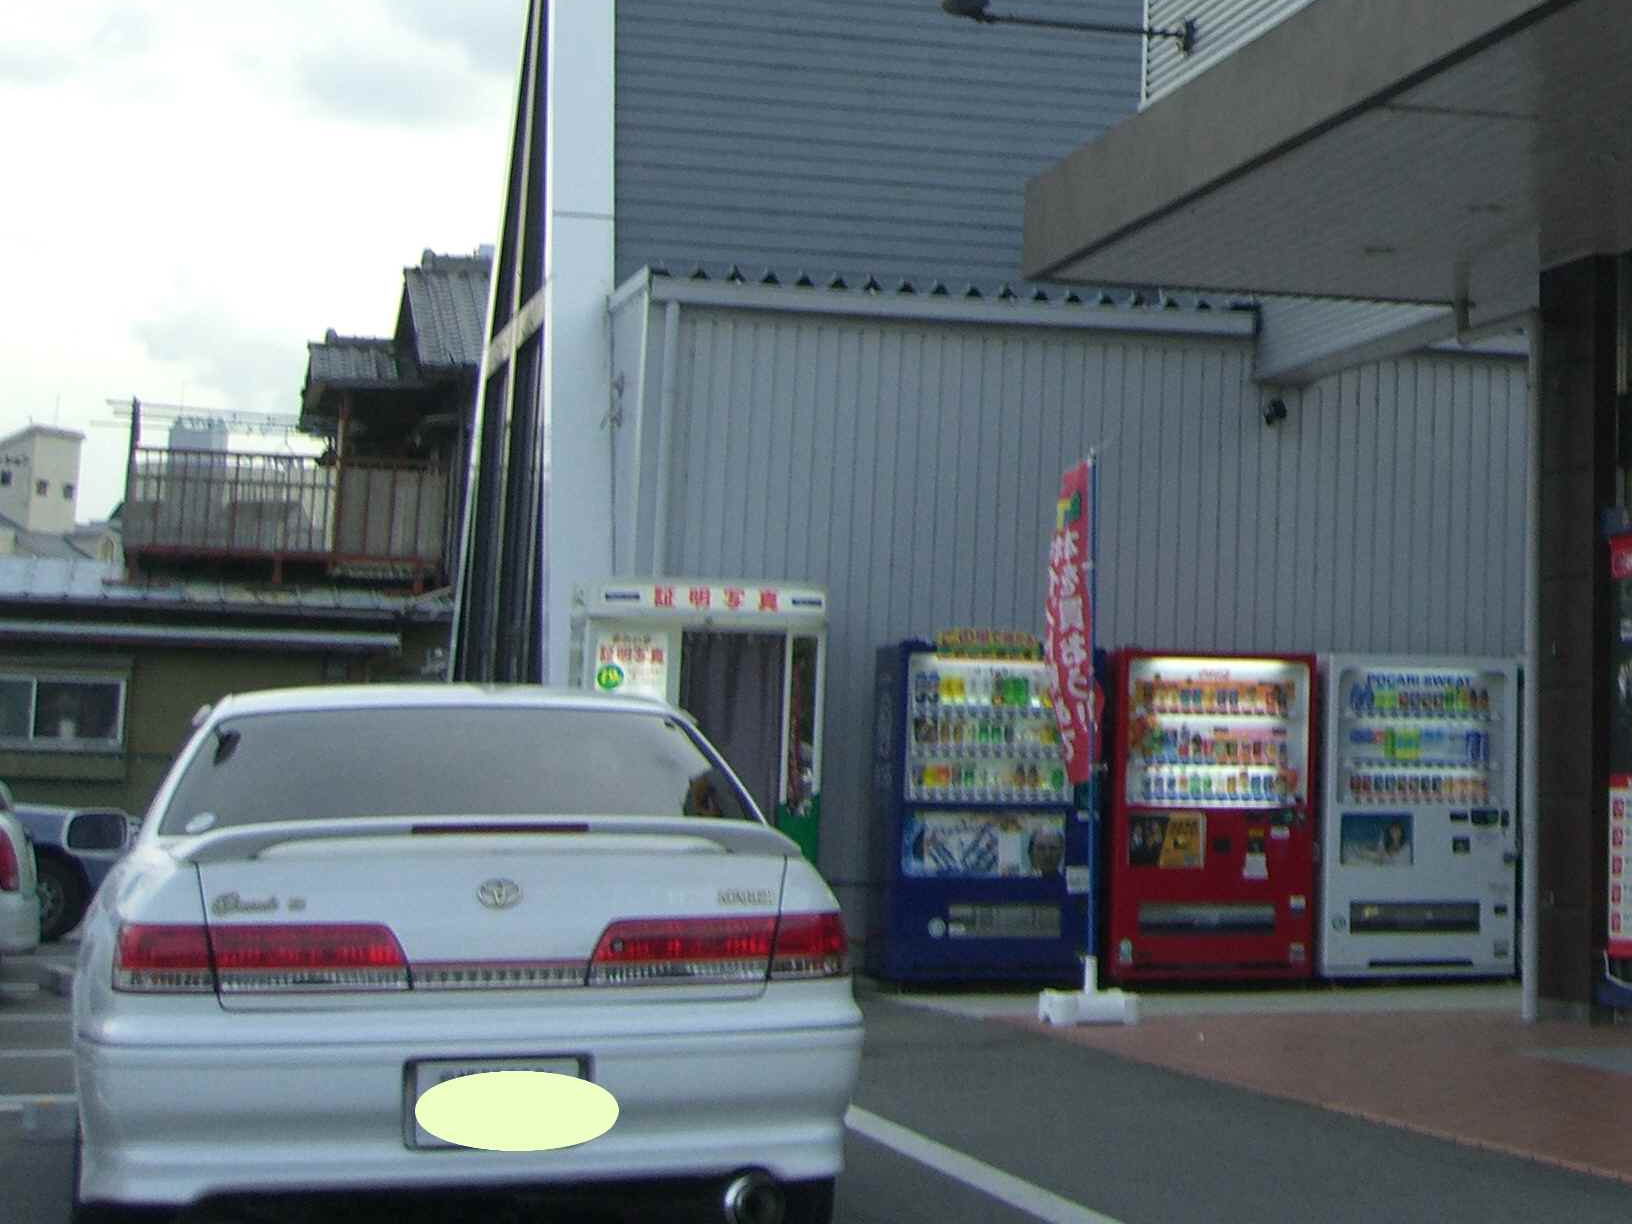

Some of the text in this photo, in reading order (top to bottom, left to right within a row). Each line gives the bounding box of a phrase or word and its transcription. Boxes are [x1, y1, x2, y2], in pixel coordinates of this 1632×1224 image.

[654, 583, 779, 612] 証明写真
[1367, 672, 1472, 690] POCARI SWEAT
